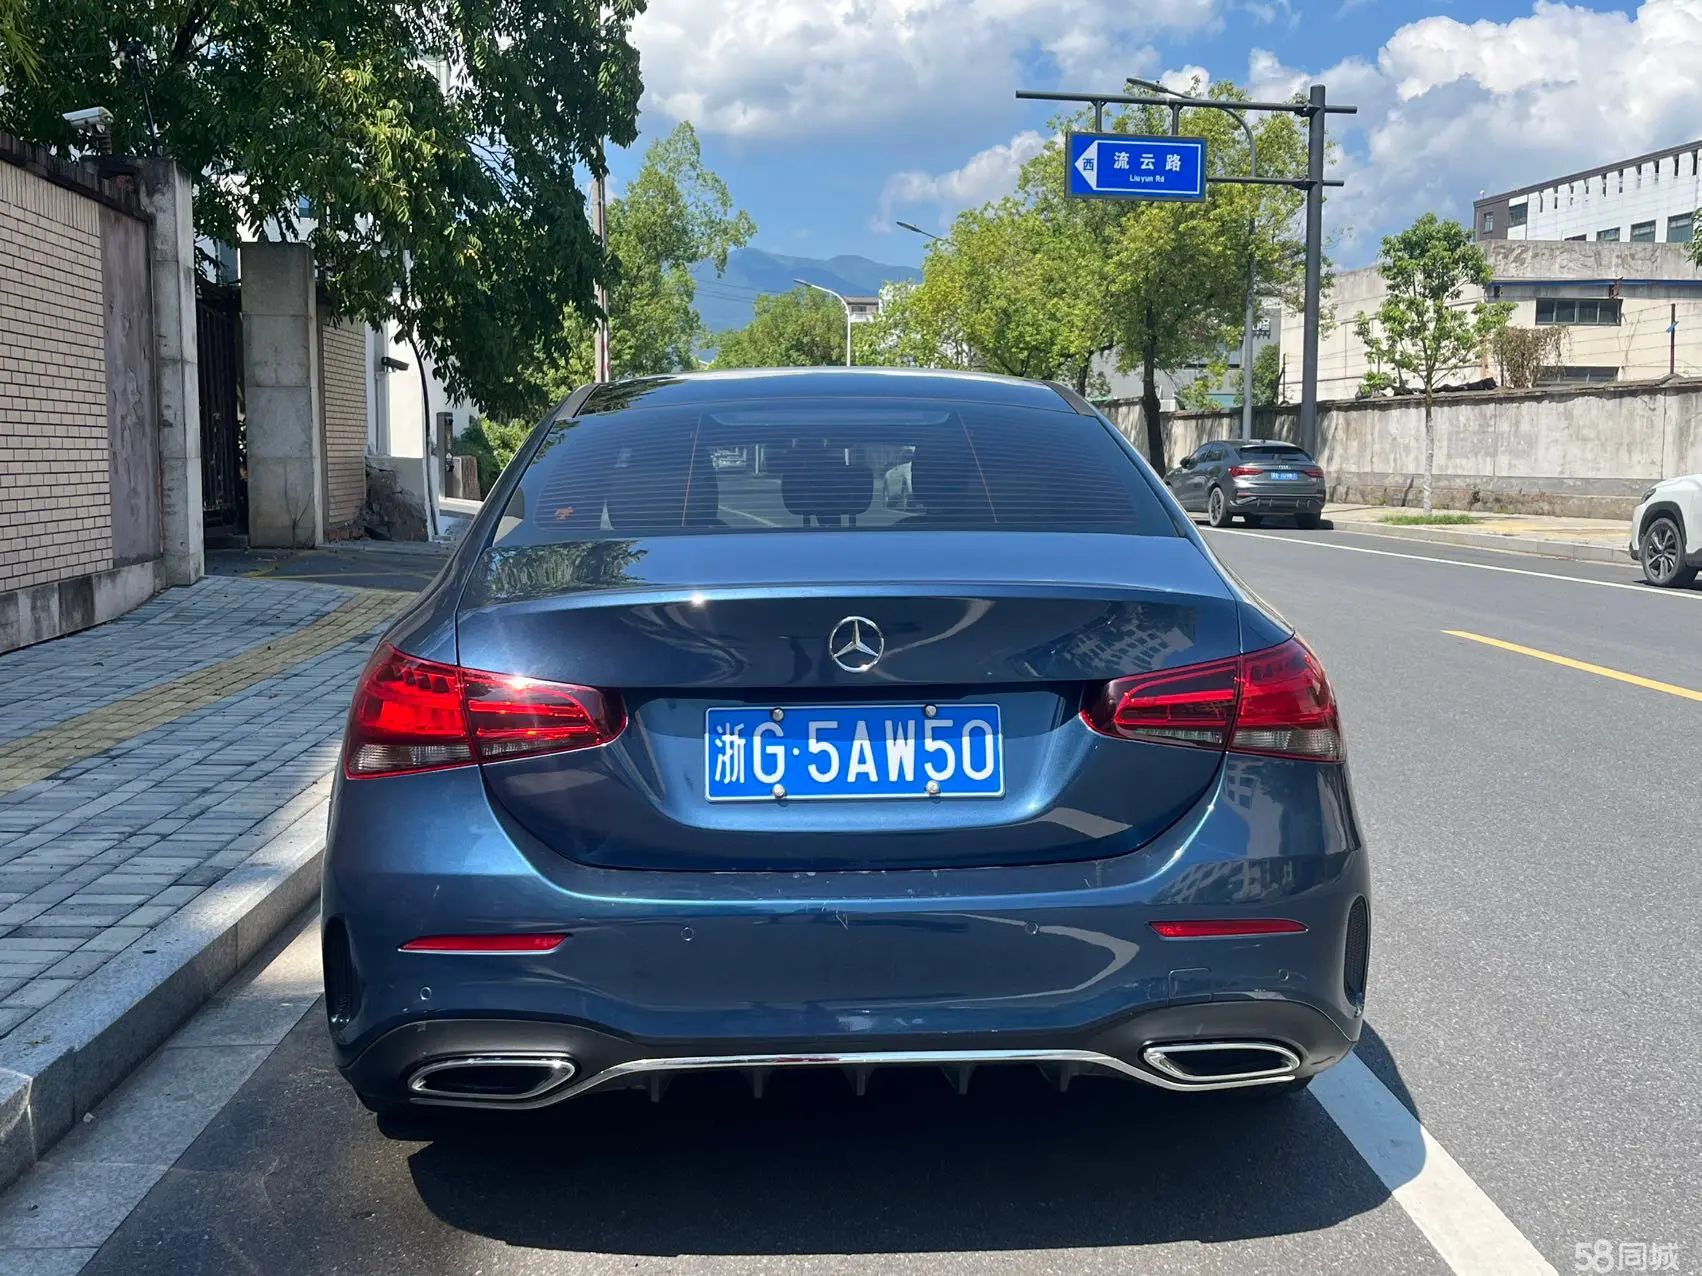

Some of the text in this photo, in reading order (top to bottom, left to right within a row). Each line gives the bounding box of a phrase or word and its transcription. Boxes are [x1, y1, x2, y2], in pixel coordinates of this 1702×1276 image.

[1083, 158, 1094, 171] 西
[1113, 151, 1182, 172] 流云路
[1129, 174, 1165, 184] Liuyun Rd
